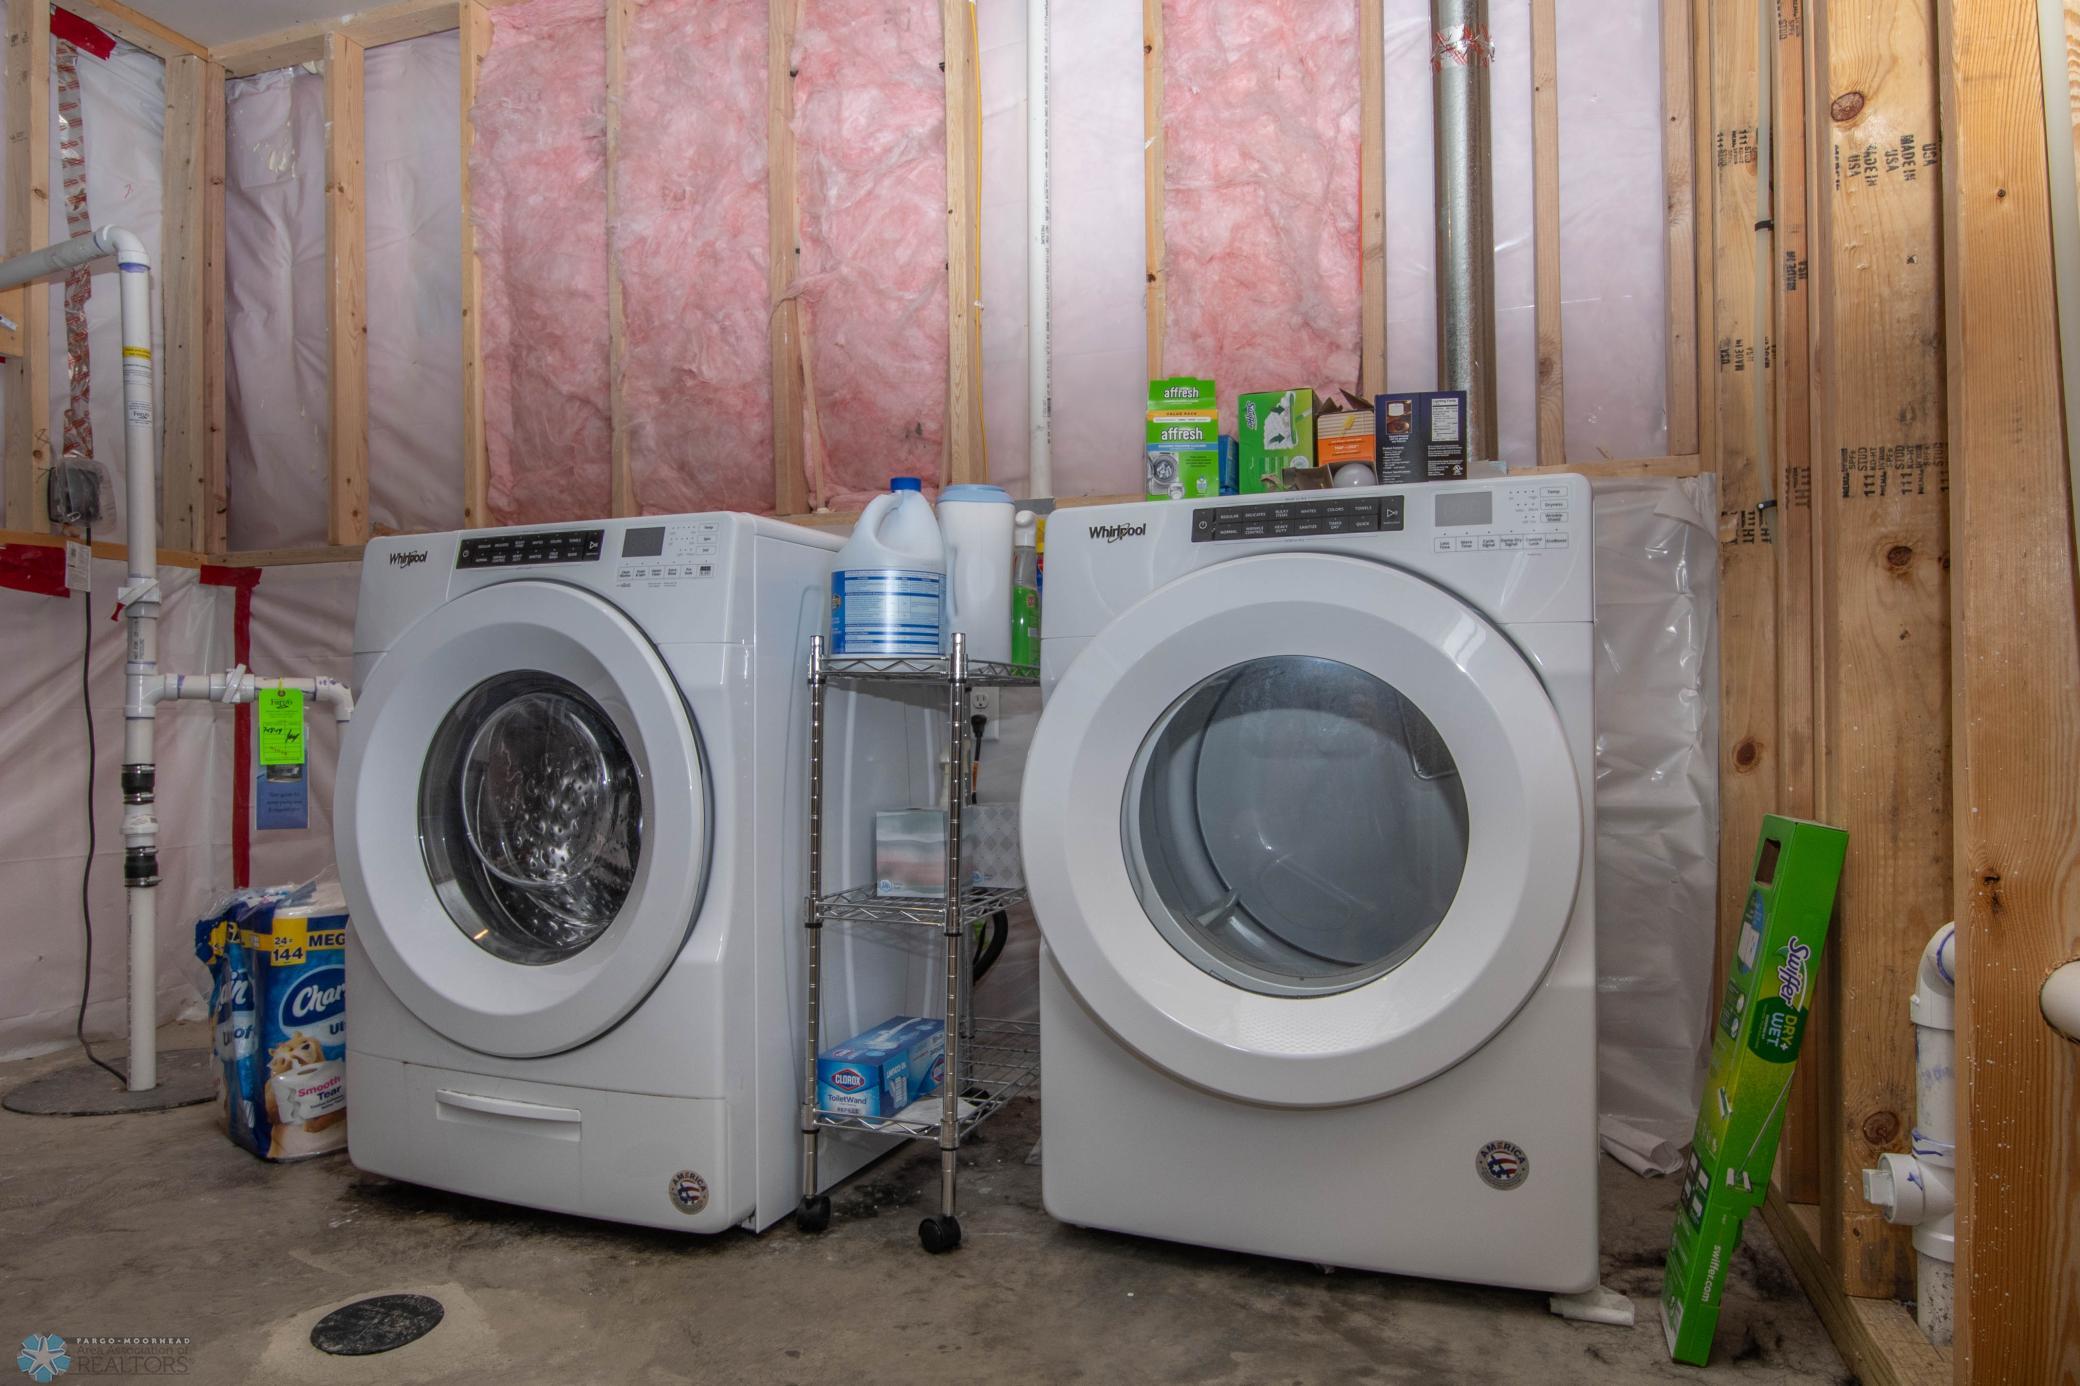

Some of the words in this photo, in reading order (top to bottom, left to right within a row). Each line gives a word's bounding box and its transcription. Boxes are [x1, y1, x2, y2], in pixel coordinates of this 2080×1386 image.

[1884, 149, 1900, 173] USA
[1900, 134, 1917, 168] MADE
[1847, 154, 1862, 178] USA
[1735, 349, 1744, 371] MADE
[1164, 386, 1199, 398] affresh
[1161, 427, 1203, 441] affresh
[1857, 447, 1868, 472] STUD
[1894, 445, 1906, 471] STUD
[1863, 474, 1876, 497] 111
[1900, 472, 1913, 496] 111
[1089, 523, 1146, 543] Whirlpool
[389, 549, 427, 569] Whirlpool
[273, 946, 303, 961] 144
[1778, 935, 1811, 1008] Swiffer
[1766, 1012, 1785, 1047] WET
[298, 1075, 341, 1097] Smooth
[834, 1074, 861, 1086] CLOROX
[317, 1085, 342, 1101] Tear
[828, 1094, 867, 1105] ToiletWand
[1701, 1244, 1721, 1302] swiffer.com
